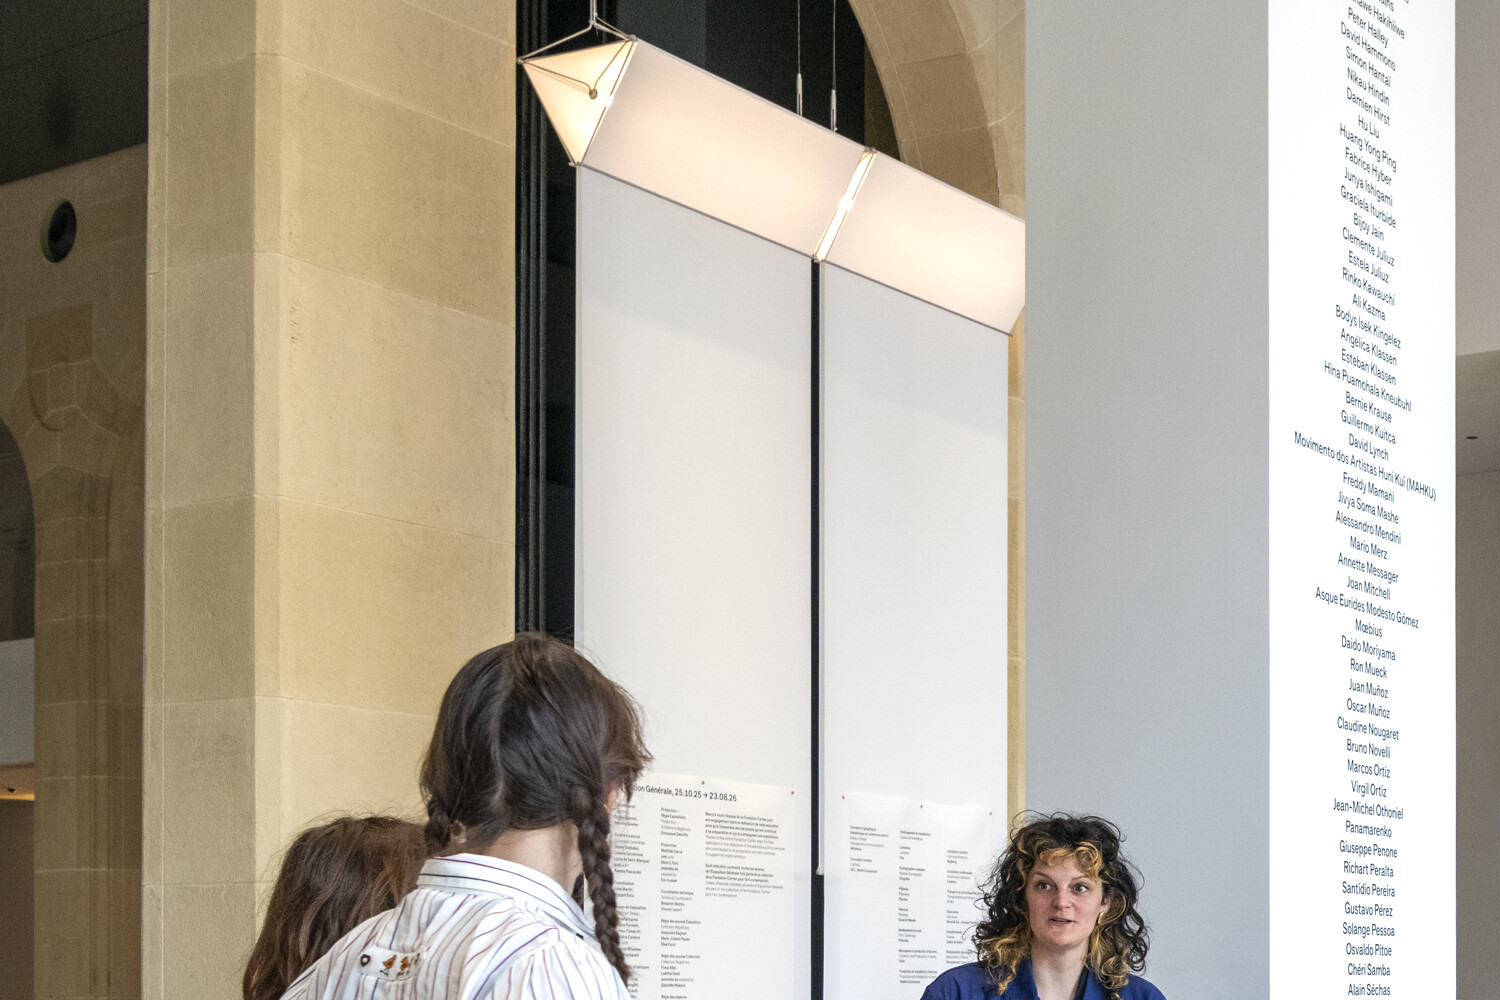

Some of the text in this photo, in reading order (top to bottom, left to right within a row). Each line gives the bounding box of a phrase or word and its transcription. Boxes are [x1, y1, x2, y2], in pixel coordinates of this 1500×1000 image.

[1348, 6, 1366, 29] Peter
[1368, 21, 1388, 48] Halley
[1340, 21, 1395, 71] David Hammons
[1346, 45, 1390, 86] Simon Hantaï
[1347, 66, 1389, 105] Nikau Hindin
[1346, 86, 1390, 126] Damien Hirst
[1358, 115, 1379, 138] Hu Liu
[1340, 123, 1396, 172] Huang Yong Ping
[1345, 146, 1391, 185] Fabrice Hyber
[1344, 167, 1392, 206] Junya Ishigami
[1340, 185, 1396, 228] Graciela Iturbide
[1353, 212, 1383, 239] Bijoy Jain
[1342, 266, 1394, 305] Rinko Kawauchi
[1352, 293, 1385, 320] Ali Kazma
[1336, 304, 1400, 348] Bodys Isek Kingelez
[1340, 328, 1396, 364] Angélica Klassen
[1341, 348, 1395, 384] Esteban Klassen
[1346, 390, 1391, 422] Bernie Krause
[1341, 409, 1395, 444] Guillermo Kuitca
[1349, 433, 1388, 460] David Lynch
[1294, 431, 1436, 500] Movimento dos Artistas Huni Kui (MAHKU)
[1343, 471, 1394, 502] Freddy Mamani
[1335, 510, 1400, 543] Alessandro Mendini
[1350, 535, 1387, 559] Mario Merz
[1338, 552, 1398, 583] Annette Messager
[1347, 576, 1390, 599] Joan Mitchell
[1315, 586, 1418, 628] Asque Eurides Modesto Gómez
[1355, 618, 1382, 637] Mœbius
[1341, 634, 1395, 660] Daido Moriyama
[1350, 657, 1387, 678] Ron Mueck
[1349, 678, 1388, 698] Juan Muñoz
[1346, 697, 1390, 718] Oscar Muñoz
[1337, 716, 1398, 740] Claudine Nougaret
[1346, 738, 1390, 758] Bruno Novelli
[1347, 758, 1390, 778] Marcos Ortiz
[646, 785, 674, 797] Générale,
[675, 788, 702, 798] 25.10.25
[709, 792, 737, 802] 23.08.26
[1333, 798, 1403, 819] Jean-Michel Othoniel
[1345, 819, 1392, 837] Panamarenko
[1339, 839, 1397, 858] Giuseppe Penone
[1343, 860, 1393, 877] Richart Peralta
[1344, 901, 1392, 916] Gustavo Pérez
[1342, 921, 1394, 937] Solange Pessoa
[1347, 962, 1390, 975] Chéri Samba
[1347, 983, 1390, 995] Alain Séchas
